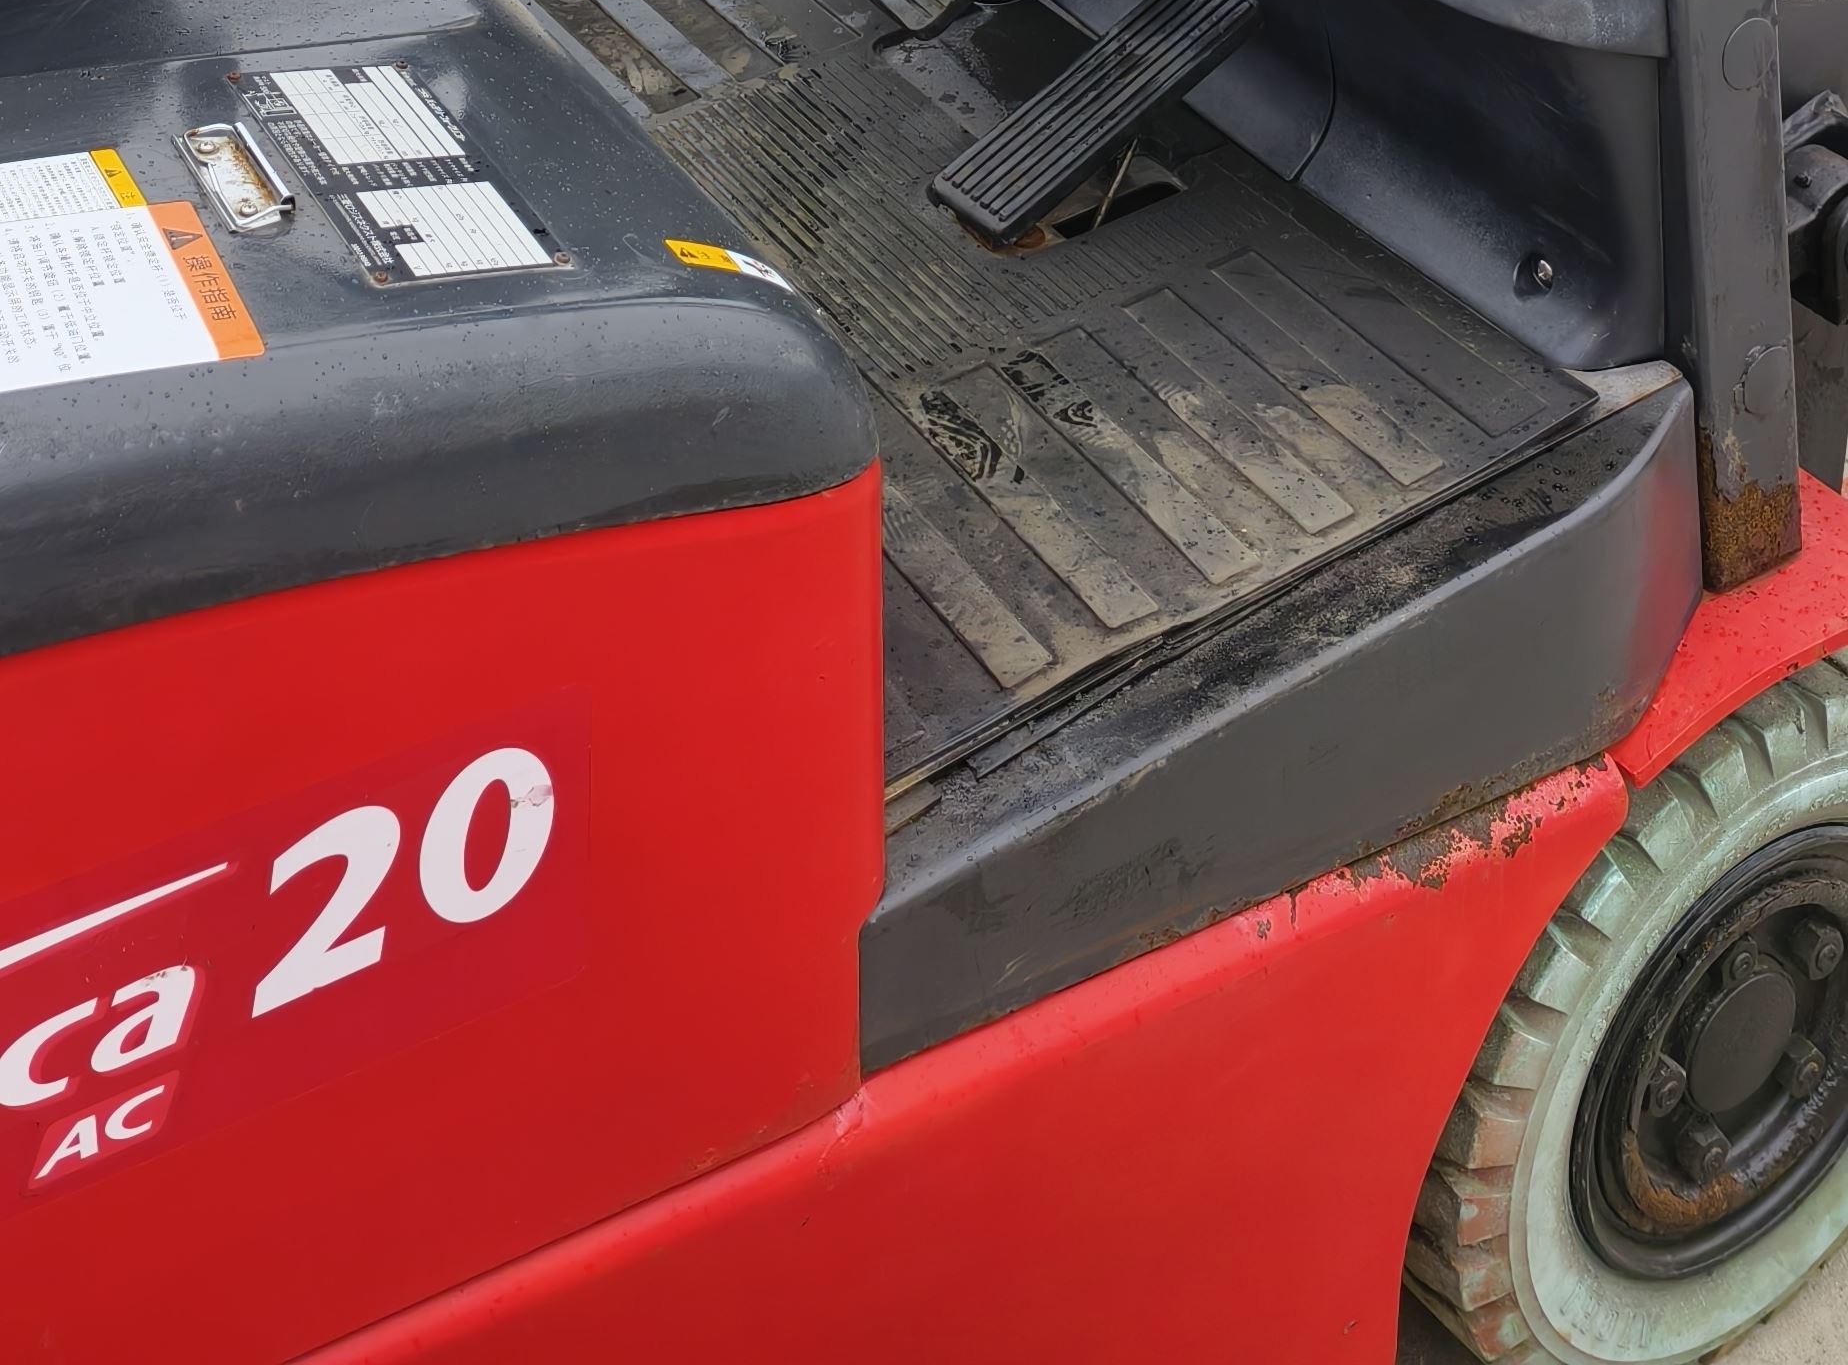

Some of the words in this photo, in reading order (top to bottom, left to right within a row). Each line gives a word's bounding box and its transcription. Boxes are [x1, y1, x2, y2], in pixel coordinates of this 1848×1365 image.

[182, 254, 238, 321] 操作指南
[252, 747, 555, 1018] 20
[35, 1084, 165, 1180] AC
